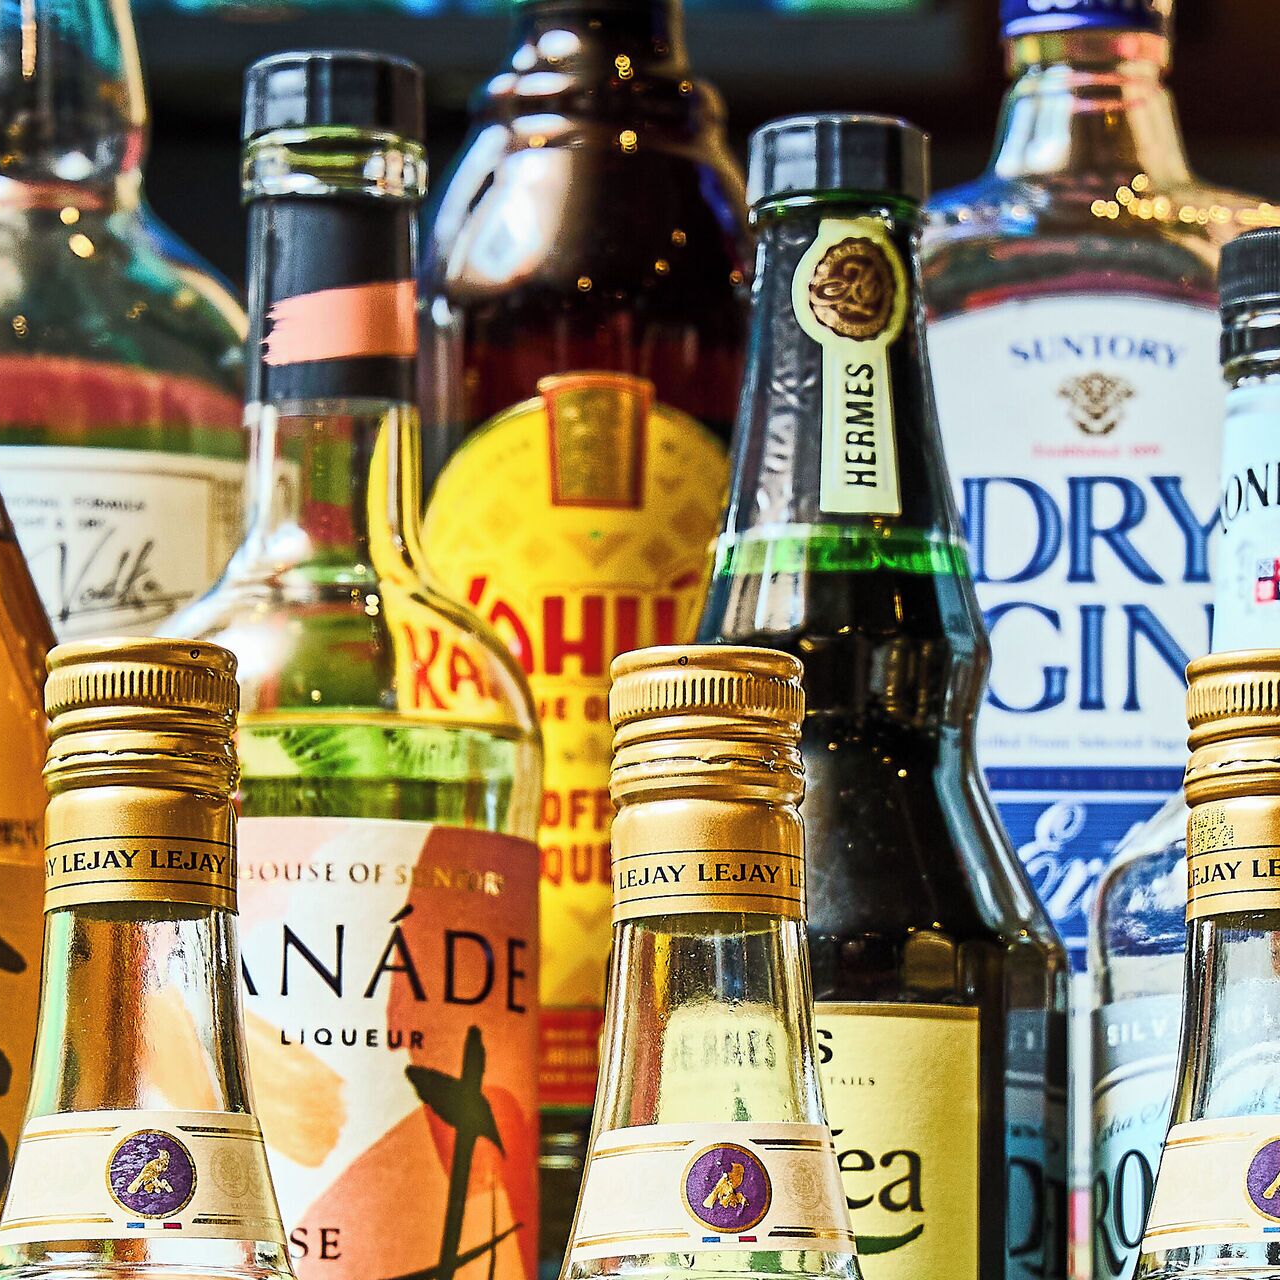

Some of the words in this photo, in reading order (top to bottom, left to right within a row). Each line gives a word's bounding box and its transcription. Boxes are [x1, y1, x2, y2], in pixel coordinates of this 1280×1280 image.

[1009, 336, 1187, 368] SUNTORY
[846, 361, 877, 487] HERMES
[960, 477, 1220, 584] DRY
[986, 603, 1214, 711] GIN
[62, 850, 140, 870] LEJAY
[349, 863, 384, 882] OF
[698, 864, 781, 883] LEJAY
[241, 907, 527, 1014] NÁDE
[281, 1028, 423, 1049] LIQUEUR
